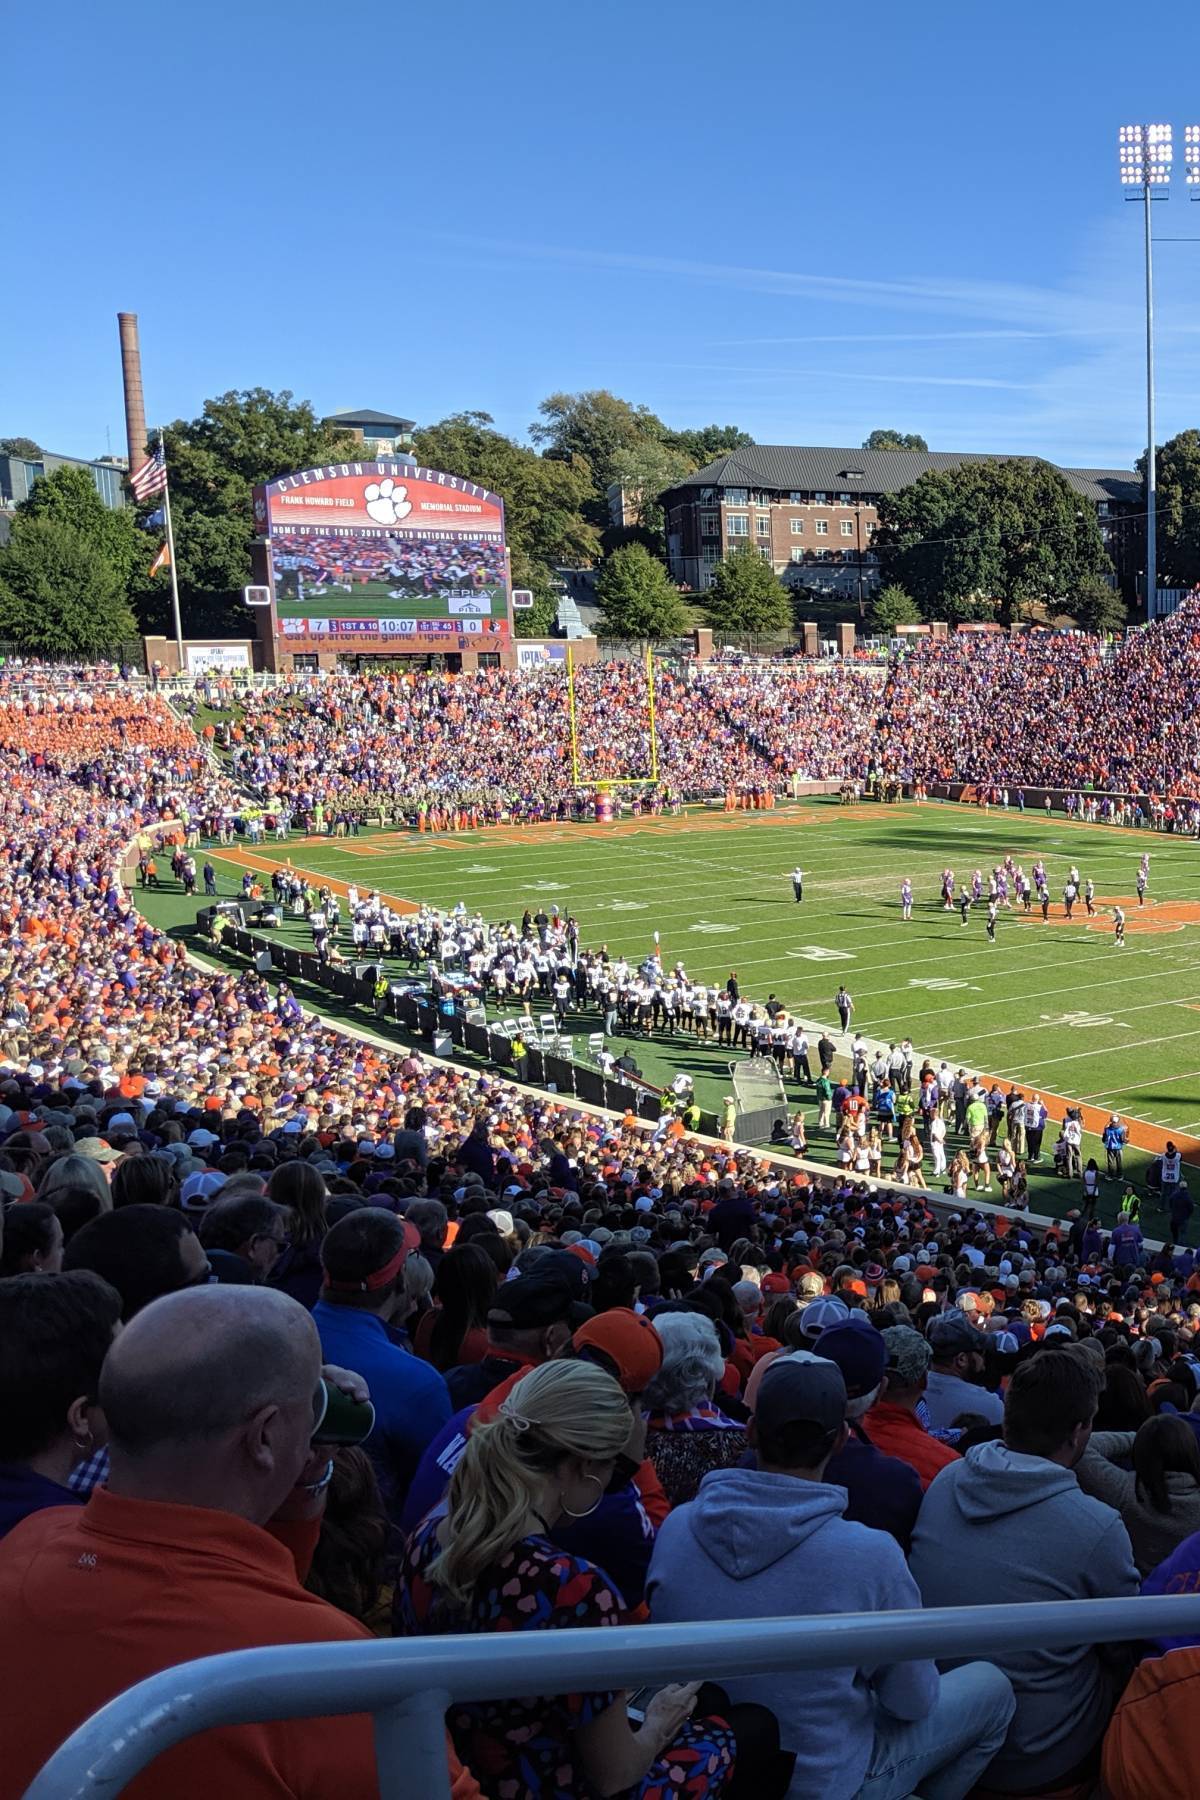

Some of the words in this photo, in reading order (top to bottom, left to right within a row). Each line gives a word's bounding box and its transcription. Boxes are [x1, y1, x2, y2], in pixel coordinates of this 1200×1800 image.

[278, 464, 363, 492] CLEMSON
[377, 463, 490, 501] UNIVERSITY
[281, 495, 304, 505] FRANK
[305, 496, 333, 506] HOWARD
[335, 498, 354, 507] FIELD
[421, 502, 453, 512] MEMORIAL
[455, 504, 482, 513] STADIUM
[272, 526, 296, 535] HOME
[301, 527, 310, 536] OF
[315, 528, 330, 536] THE
[417, 532, 454, 540] NATIONAL
[458, 533, 502, 542] CHAMPIONS
[440, 589, 496, 598] REPLAY
[315, 621, 323, 631] 7
[382, 621, 414, 632] 10:07
[469, 622, 476, 632] 0
[310, 633, 325, 644] up
[849, 1100, 858, 1111] 10
